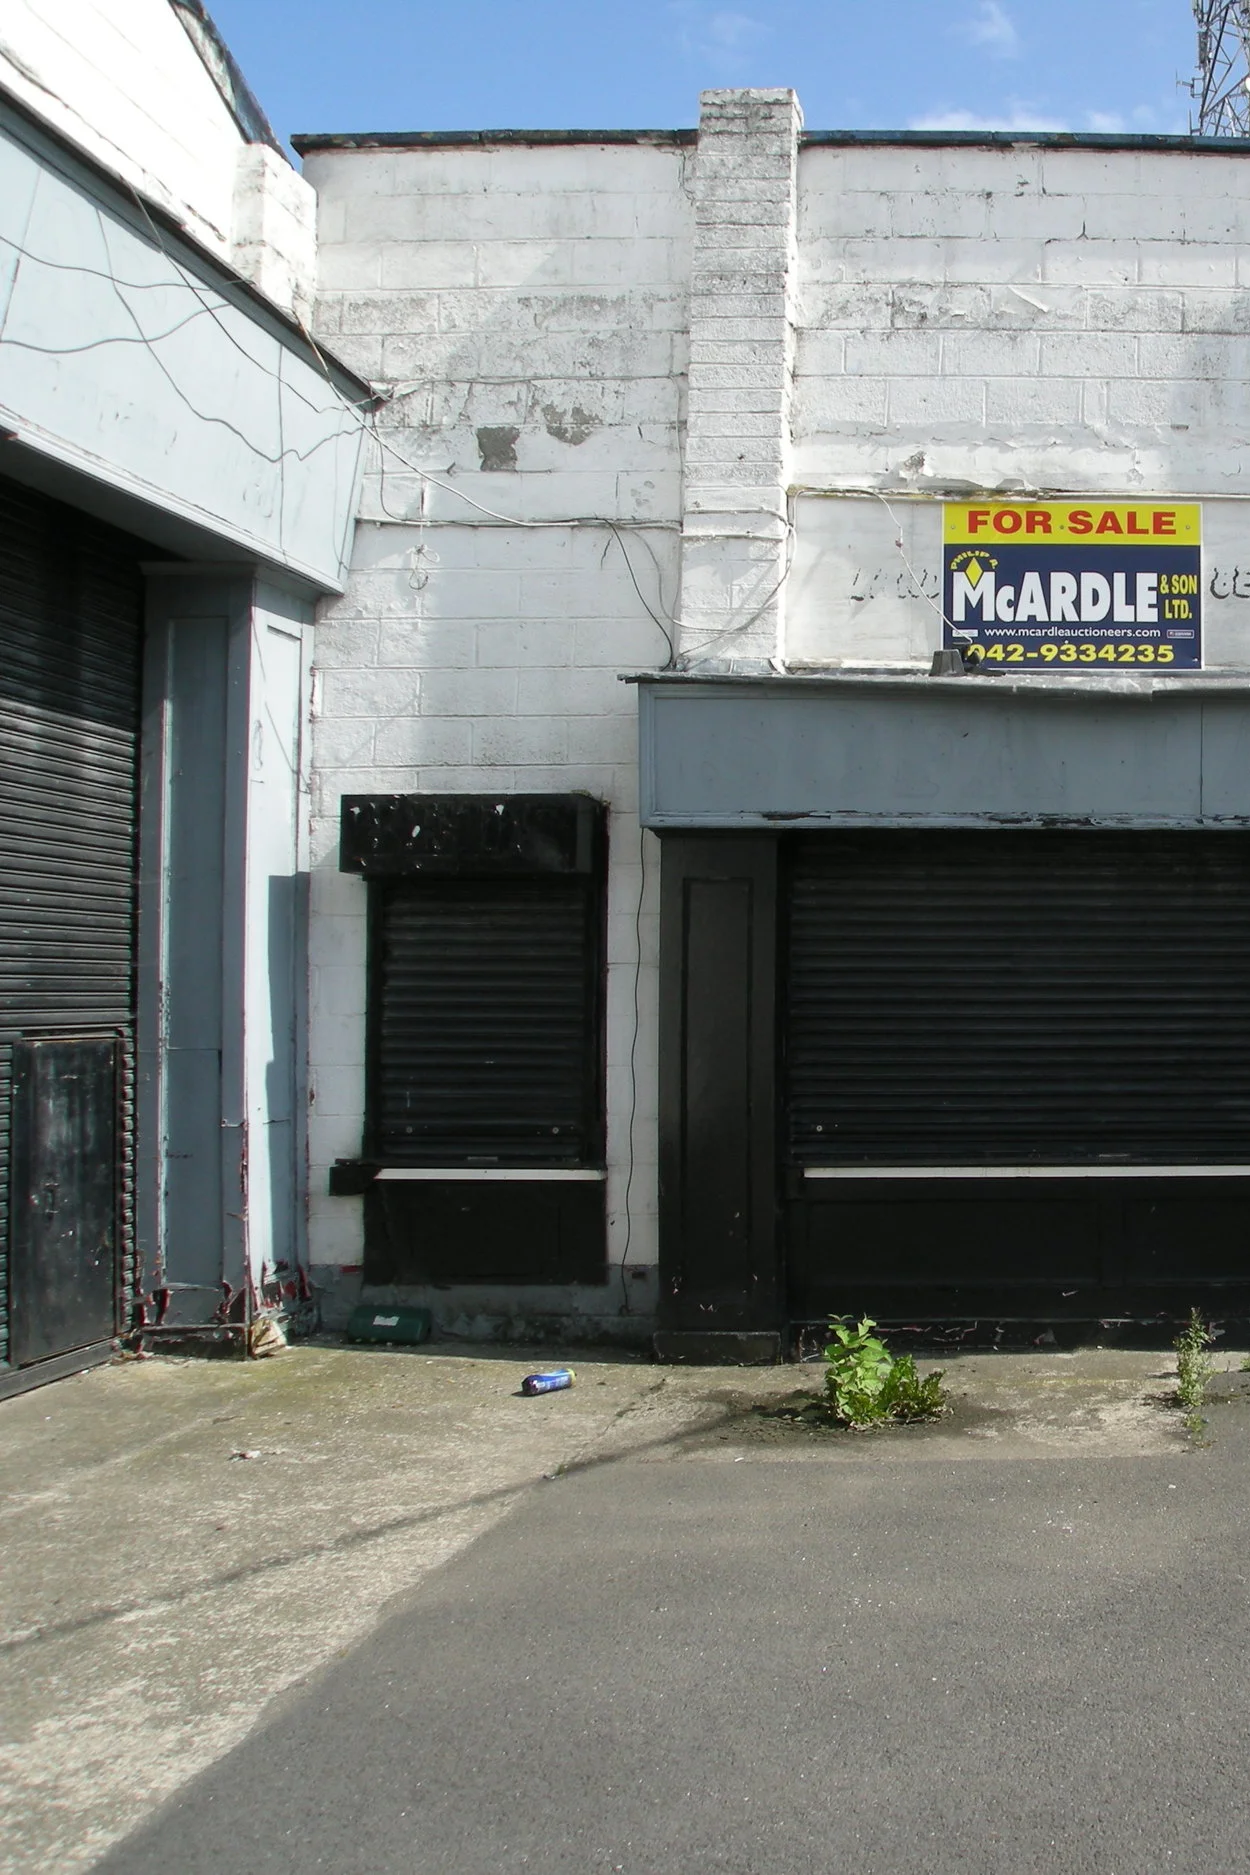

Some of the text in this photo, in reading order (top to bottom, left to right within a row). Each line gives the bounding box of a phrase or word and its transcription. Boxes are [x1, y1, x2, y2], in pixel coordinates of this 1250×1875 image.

[968, 510, 1177, 535] FOR SALE
[950, 550, 990, 570] PHILIP
[952, 571, 1158, 622] McARDLE
[1160, 574, 1169, 594] &
[1171, 574, 1197, 594] SON
[1165, 599, 1192, 619] LTD.
[984, 626, 1161, 638] www.mcardleauctioneers.com
[967, 643, 1174, 662] 042-9334235
